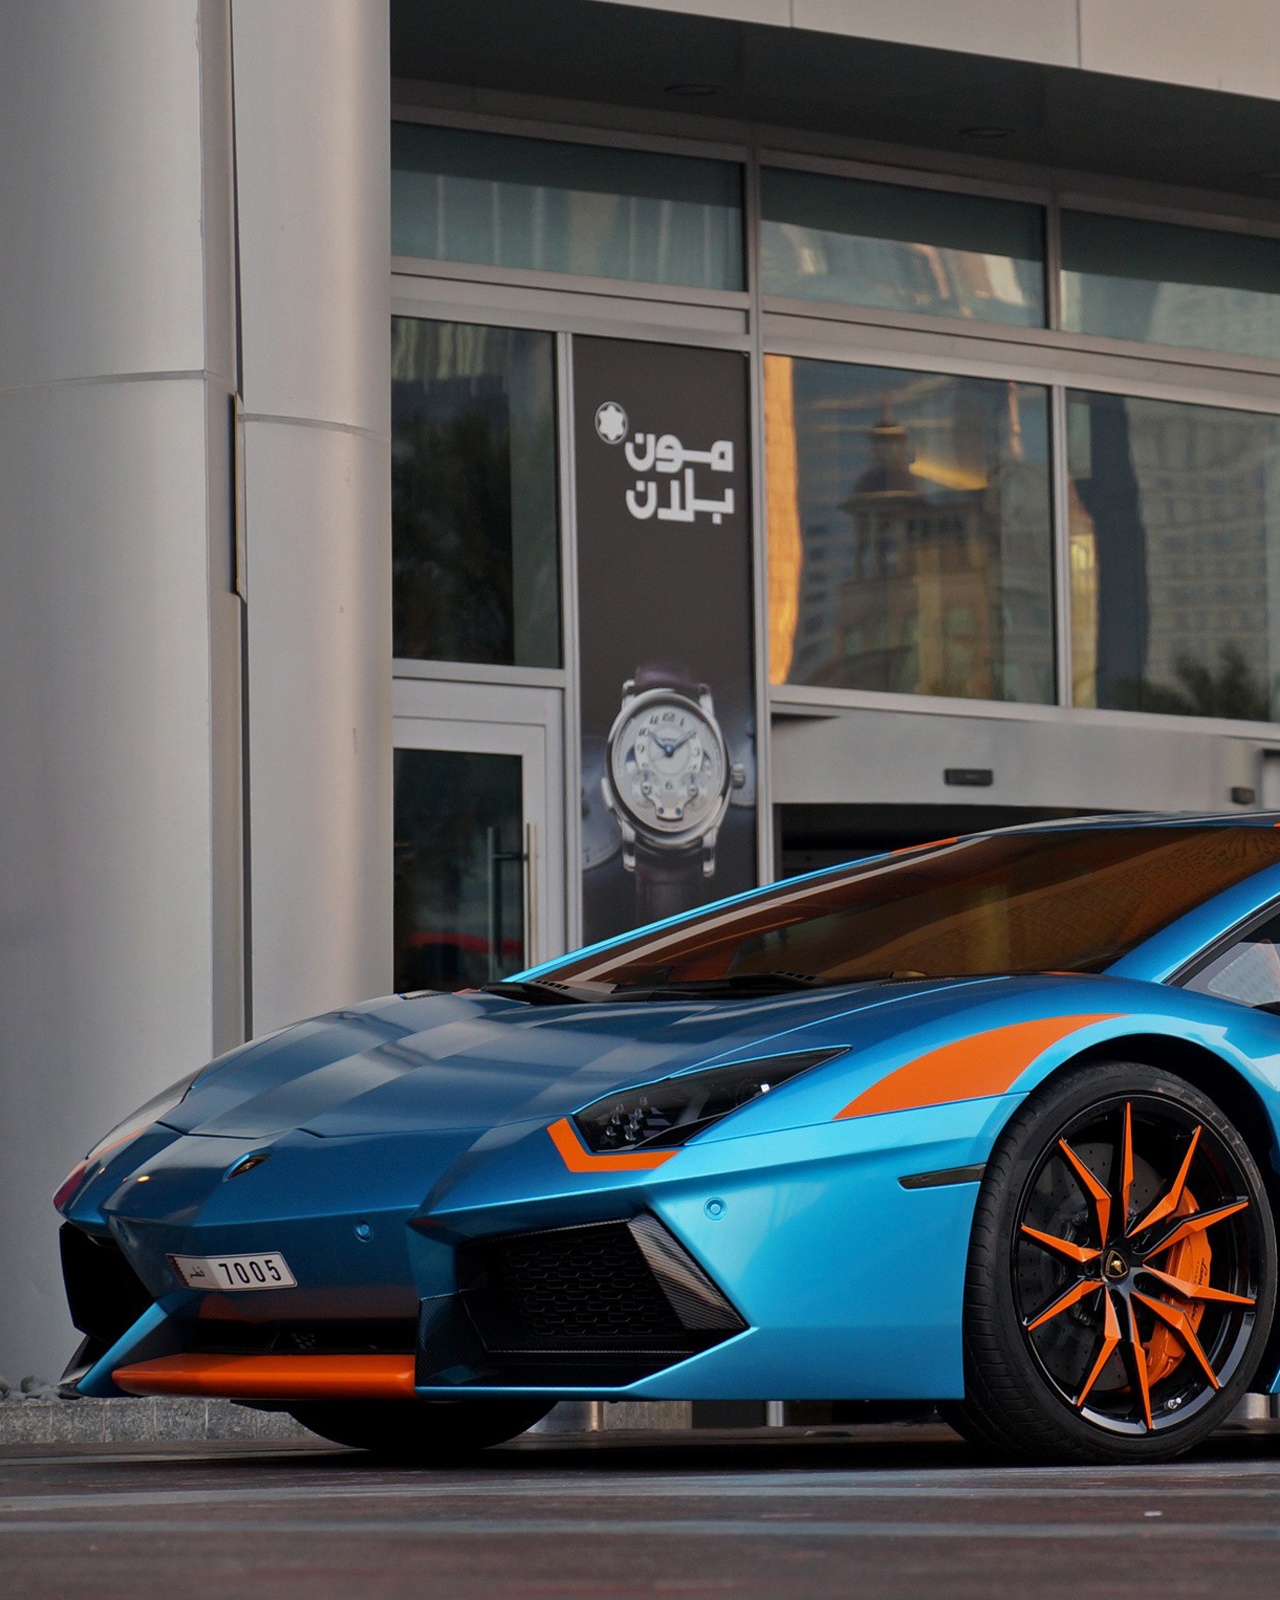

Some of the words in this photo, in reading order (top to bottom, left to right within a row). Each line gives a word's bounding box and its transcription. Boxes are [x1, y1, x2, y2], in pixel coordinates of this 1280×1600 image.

[625, 432, 735, 473] مون
[626, 467, 735, 525] بلان
[218, 1259, 282, 1285] 7005
